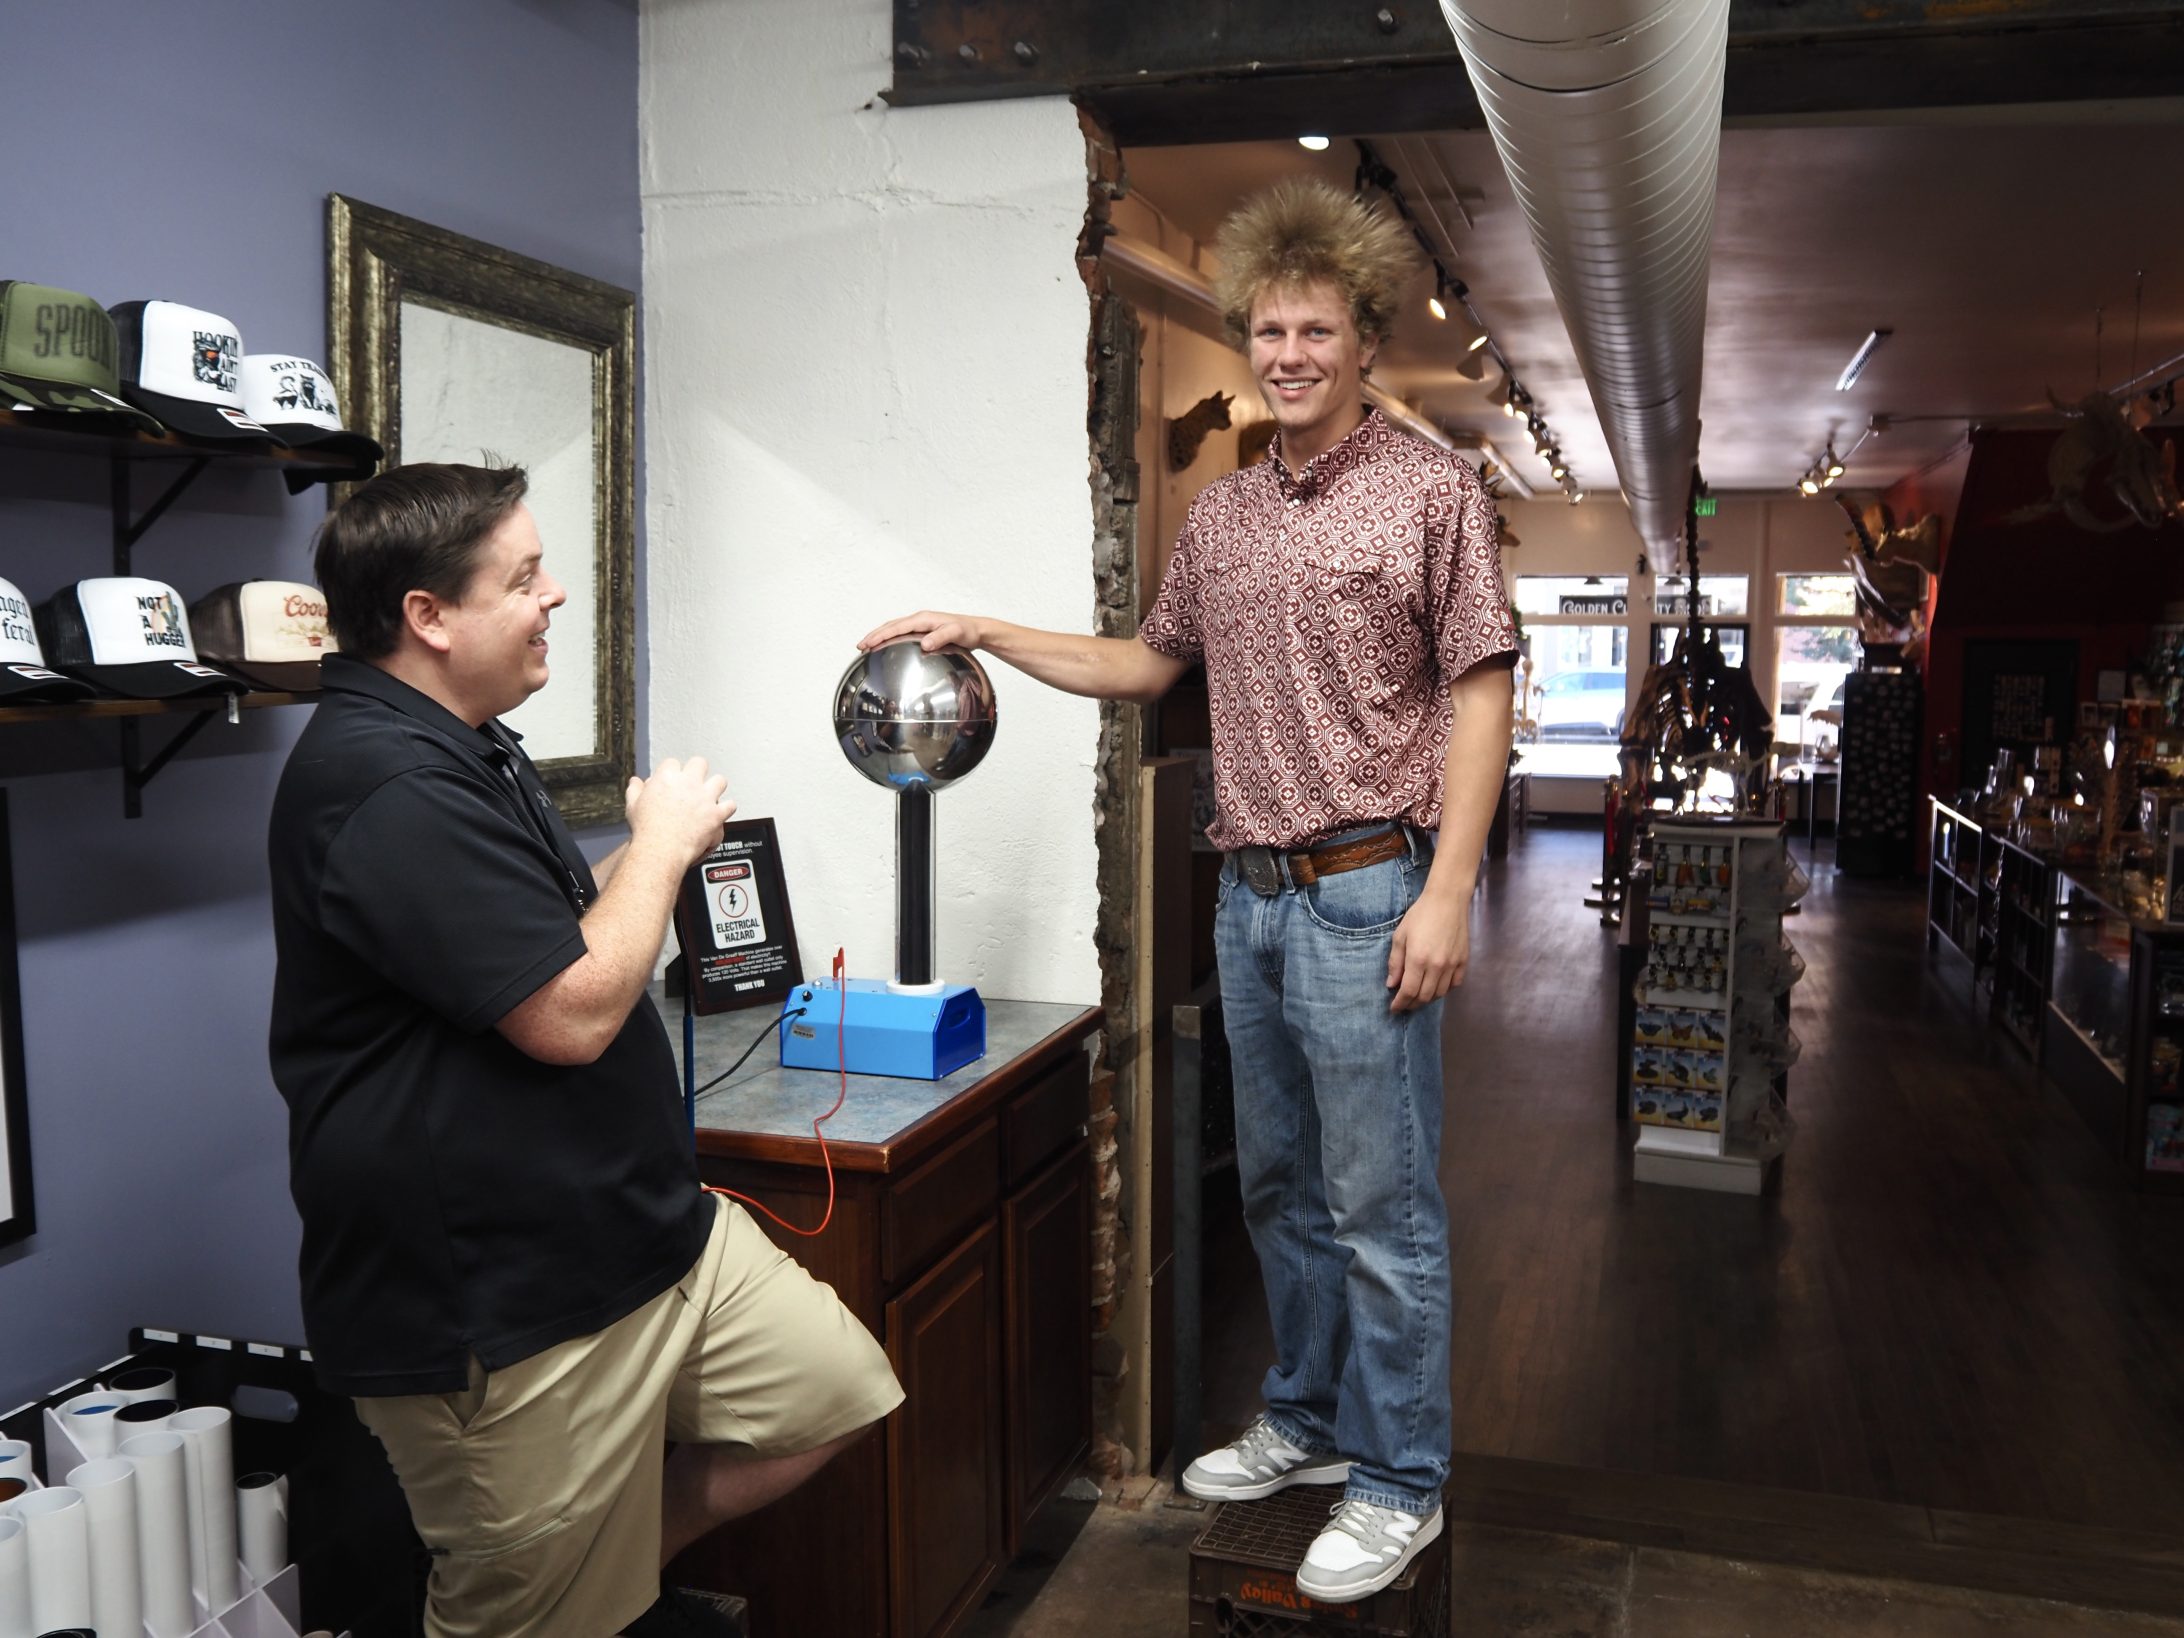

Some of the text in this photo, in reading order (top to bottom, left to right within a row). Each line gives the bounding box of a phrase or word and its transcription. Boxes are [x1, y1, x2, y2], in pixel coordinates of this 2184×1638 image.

[270, 361, 297, 372] STAY
[136, 596, 162, 611] NOT
[1562, 600, 1609, 615] GOLDEN
[724, 841, 743, 850] TOUCH
[714, 868, 743, 879] DANGER
[716, 917, 760, 933] ELECTRICAL
[725, 929, 755, 943] HAZARD
[754, 979, 765, 988] YOU
